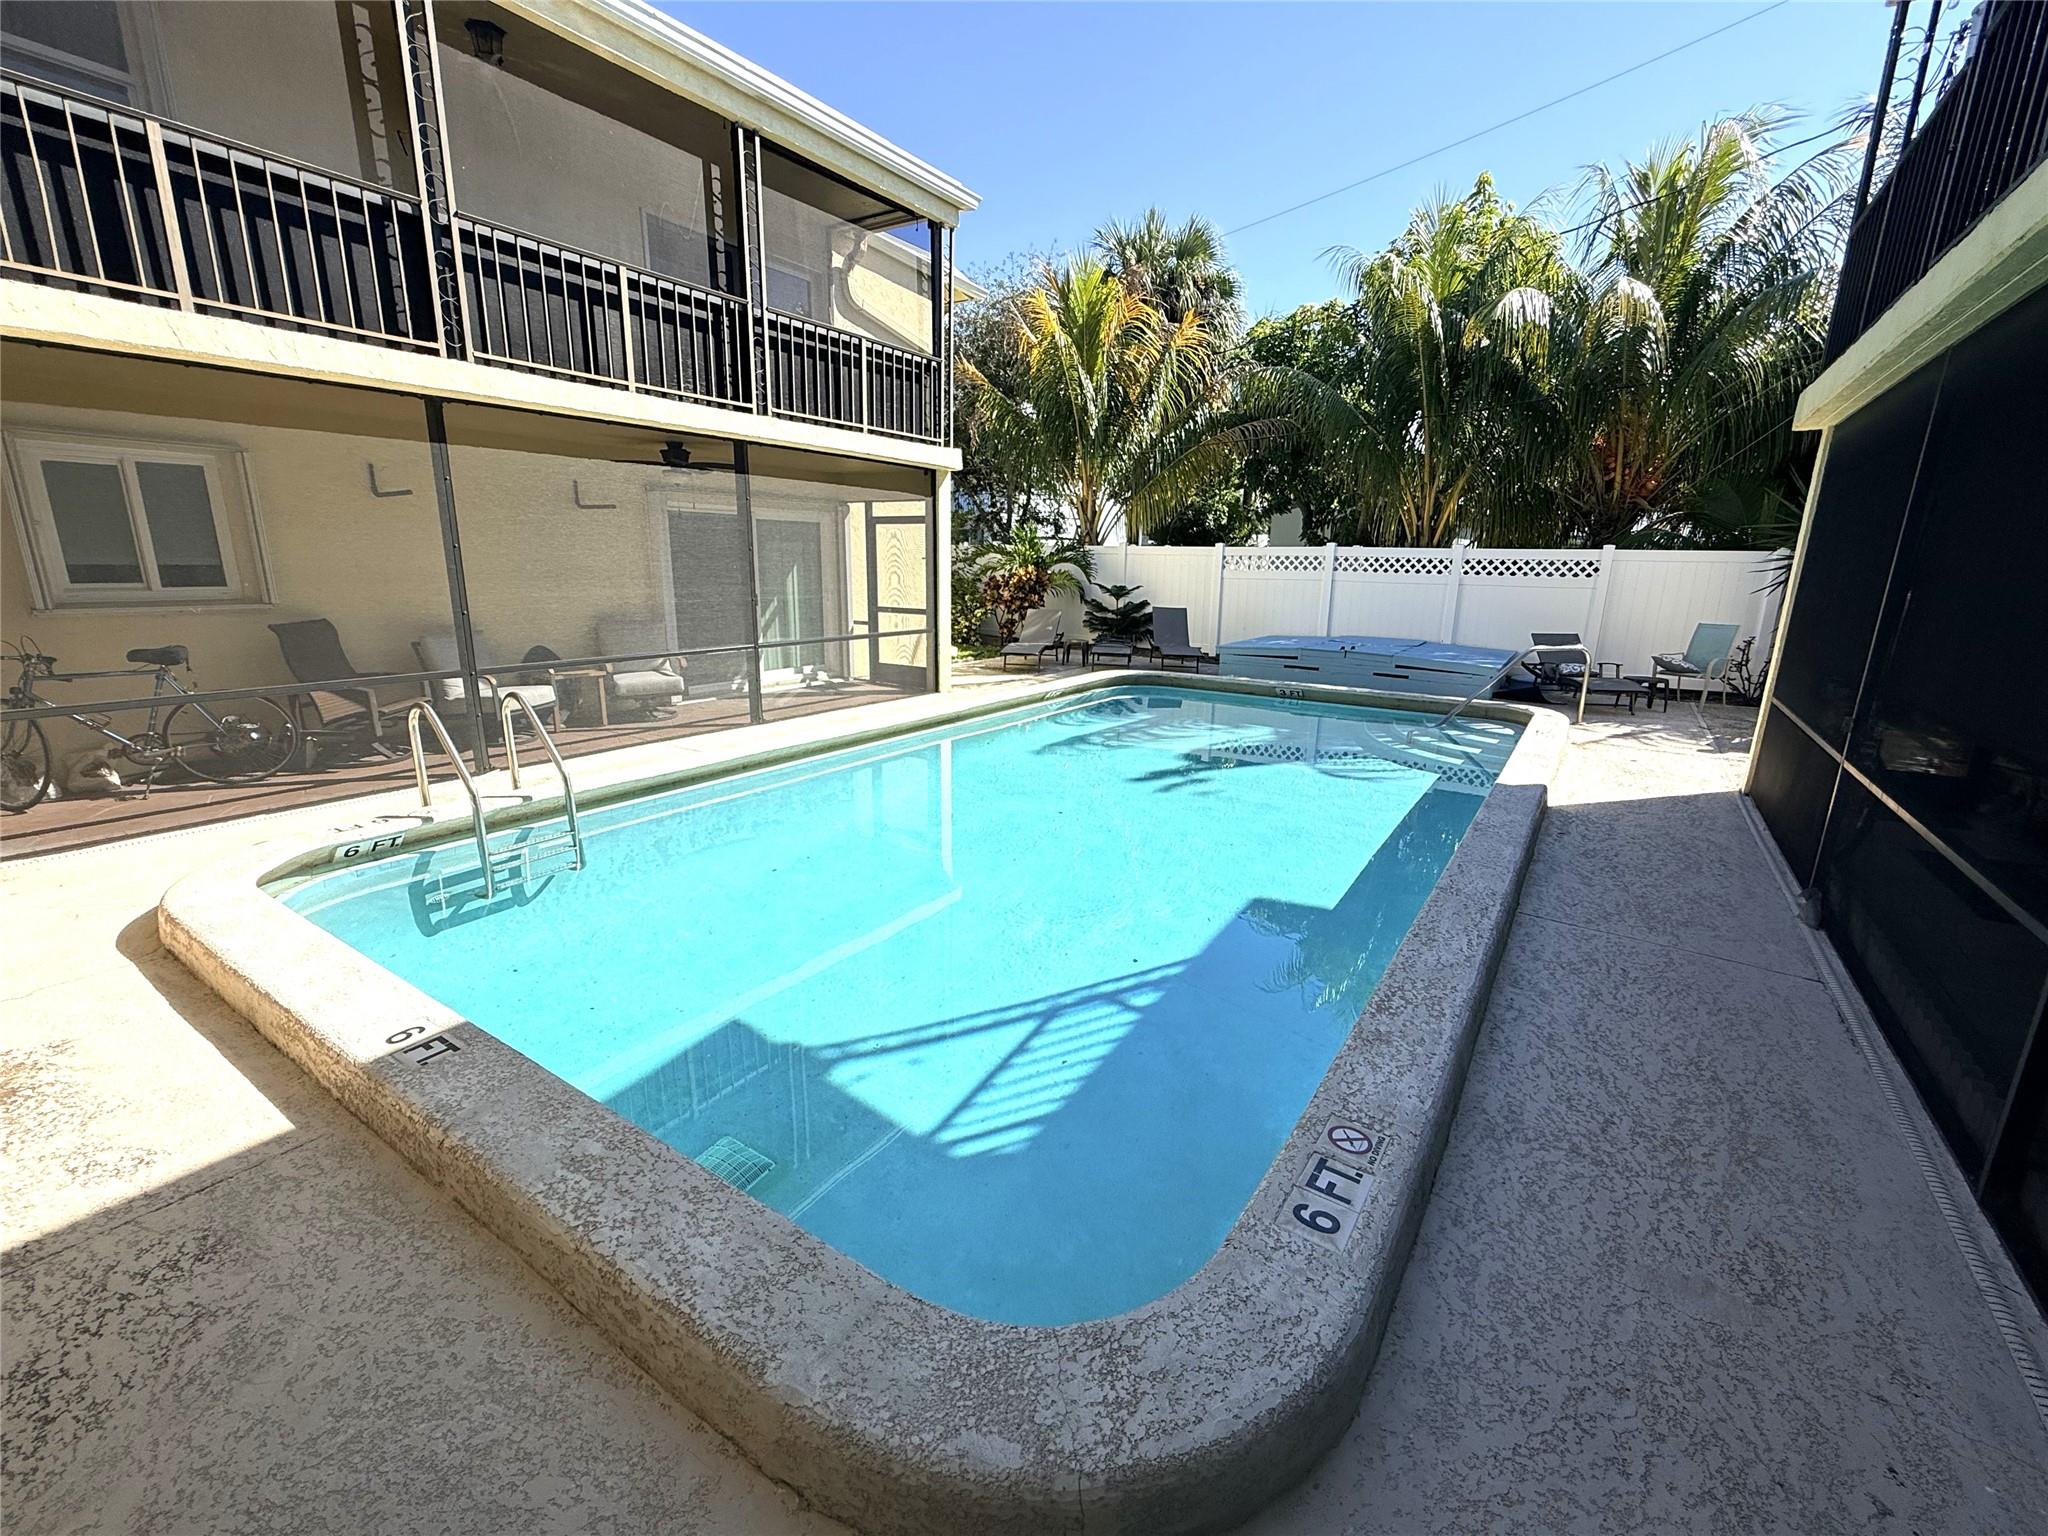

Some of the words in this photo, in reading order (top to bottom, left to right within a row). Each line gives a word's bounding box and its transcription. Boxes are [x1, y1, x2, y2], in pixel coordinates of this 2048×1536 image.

[343, 845, 361, 858] 6
[385, 1026, 426, 1044] 6
[1371, 1135, 1386, 1157] DIVING
[1367, 1155, 1378, 1167] NO
[1292, 1203, 1341, 1235] 6
